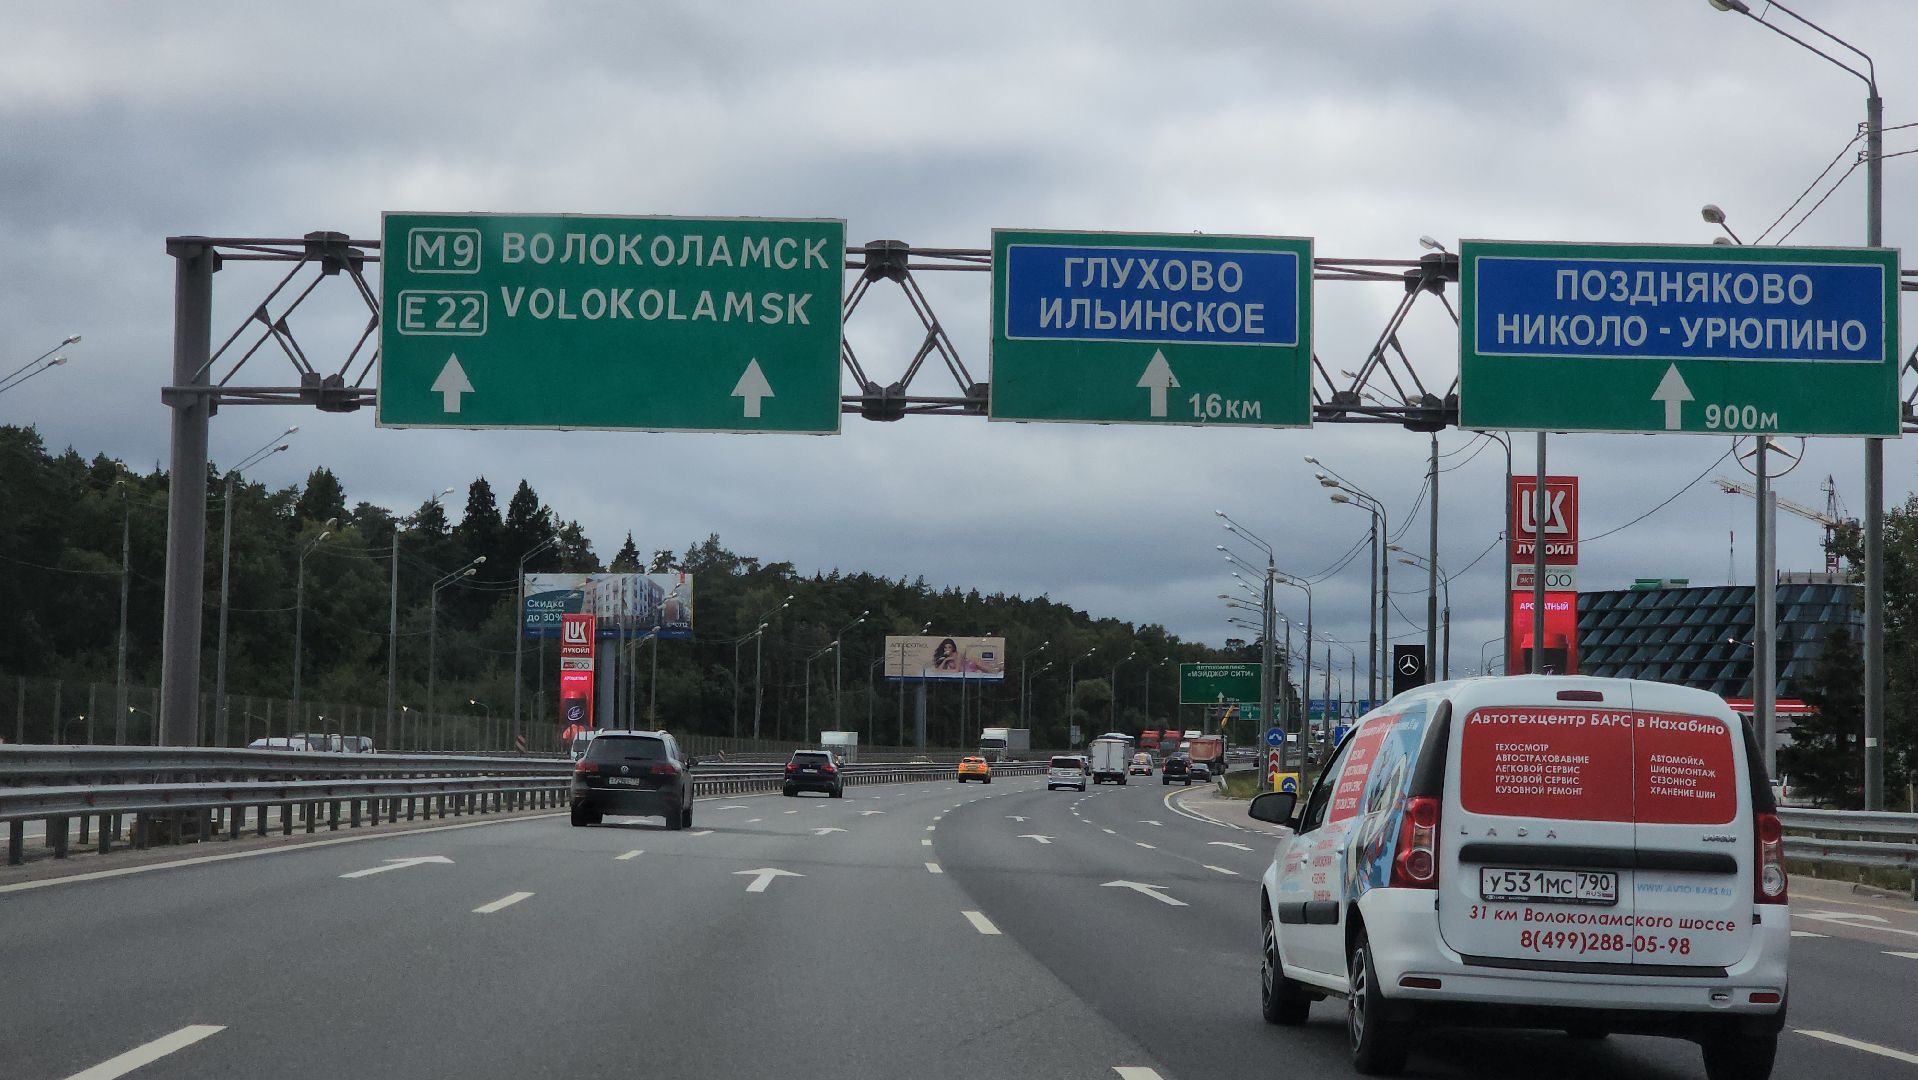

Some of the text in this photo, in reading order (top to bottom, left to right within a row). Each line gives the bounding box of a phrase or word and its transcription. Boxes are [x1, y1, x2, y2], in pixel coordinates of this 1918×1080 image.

[502, 232, 829, 270] ВОЛОКОЛАМСК
[1064, 257, 1243, 293] ГЛУХОВО
[1556, 269, 1813, 306] ПОЗДНЯКОВО
[500, 286, 813, 326] VOLOKOLAMSK
[1040, 297, 1265, 334] ИЛЬИНСКОЕ
[1498, 313, 1648, 347] НИКОЛО
[1679, 316, 1867, 351] УРЮПИНО
[1517, 542, 1574, 555] ЛУОЙЛ
[527, 599, 564, 609] Скидка
[1520, 602, 1569, 611] АРОАТНЫЙ
[527, 613, 540, 622] до
[1471, 711, 1725, 735] Автотехцентр БАРС в Нахабино
[1495, 743, 1549, 752] ТЕХОСМОТР
[1651, 753, 1705, 766] АВТОМОЙКА
[1495, 763, 1580, 774] ЛЕГКОВОЙ СЕРВИС
[1650, 765, 1716, 778] ШИНОМОНТАЖ
[1495, 774, 1580, 784] ГРУЗОВОЙ СЕРВИС
[1650, 776, 1697, 787] СЕЗОННОЕ
[1495, 785, 1583, 795] КУЗОВНОЙ РЕМОНТ
[1650, 787, 1716, 799] ХРАНЕНИЕ ШИН
[1461, 825, 1557, 839] LADA
[1469, 904, 1736, 932] 31 км Волоколамского шоссе
[1520, 930, 1691, 955] 8(499)288-05-98
